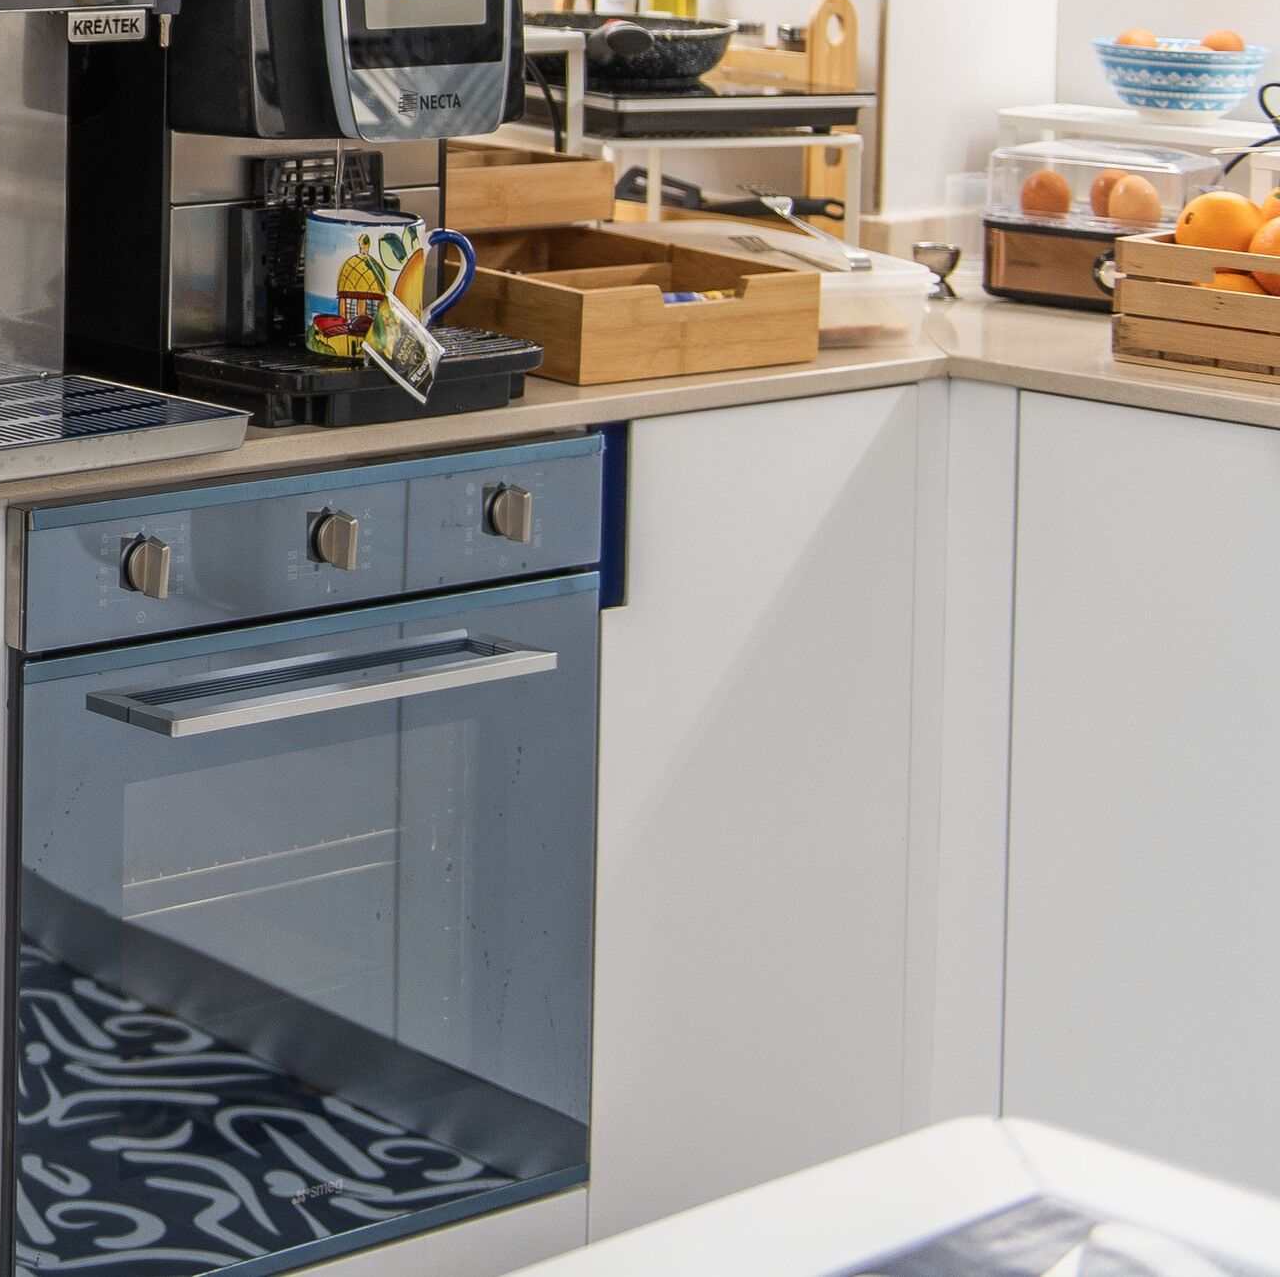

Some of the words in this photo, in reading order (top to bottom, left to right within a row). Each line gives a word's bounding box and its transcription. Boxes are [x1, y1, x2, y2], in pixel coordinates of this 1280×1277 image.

[73, 17, 140, 36] KREATEK
[420, 93, 461, 110] NECTA
[310, 1179, 343, 1198] smeg
